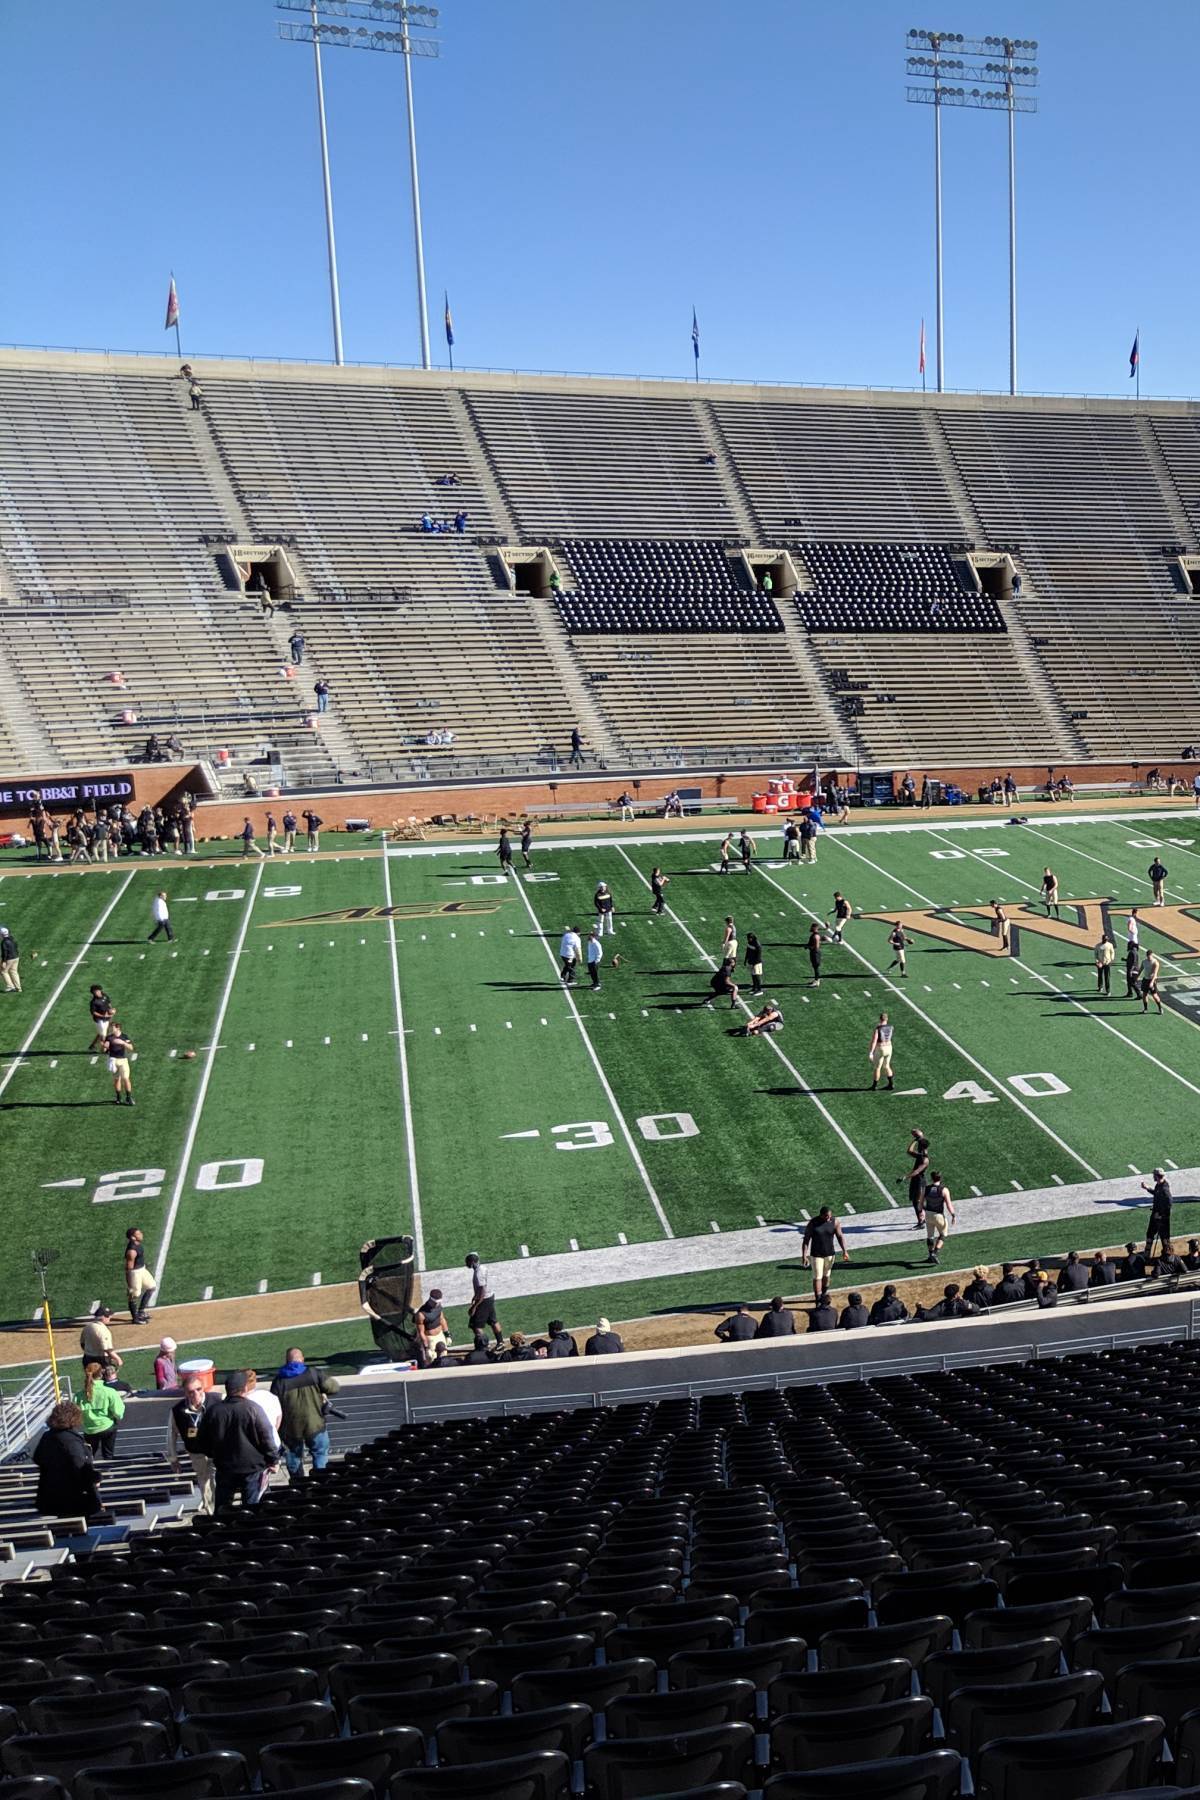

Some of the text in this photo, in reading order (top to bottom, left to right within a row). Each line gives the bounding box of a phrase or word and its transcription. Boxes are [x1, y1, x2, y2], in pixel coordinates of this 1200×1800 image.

[16, 789, 39, 802] TO
[41, 785, 79, 801] BB&T
[83, 782, 132, 798] FIELD
[777, 795, 790, 807] G
[1126, 837, 1197, 849] 40
[929, 847, 1010, 860] 50
[942, 1072, 1072, 1104] 40
[550, 1112, 701, 1151] 30
[92, 1158, 264, 1203] 20
